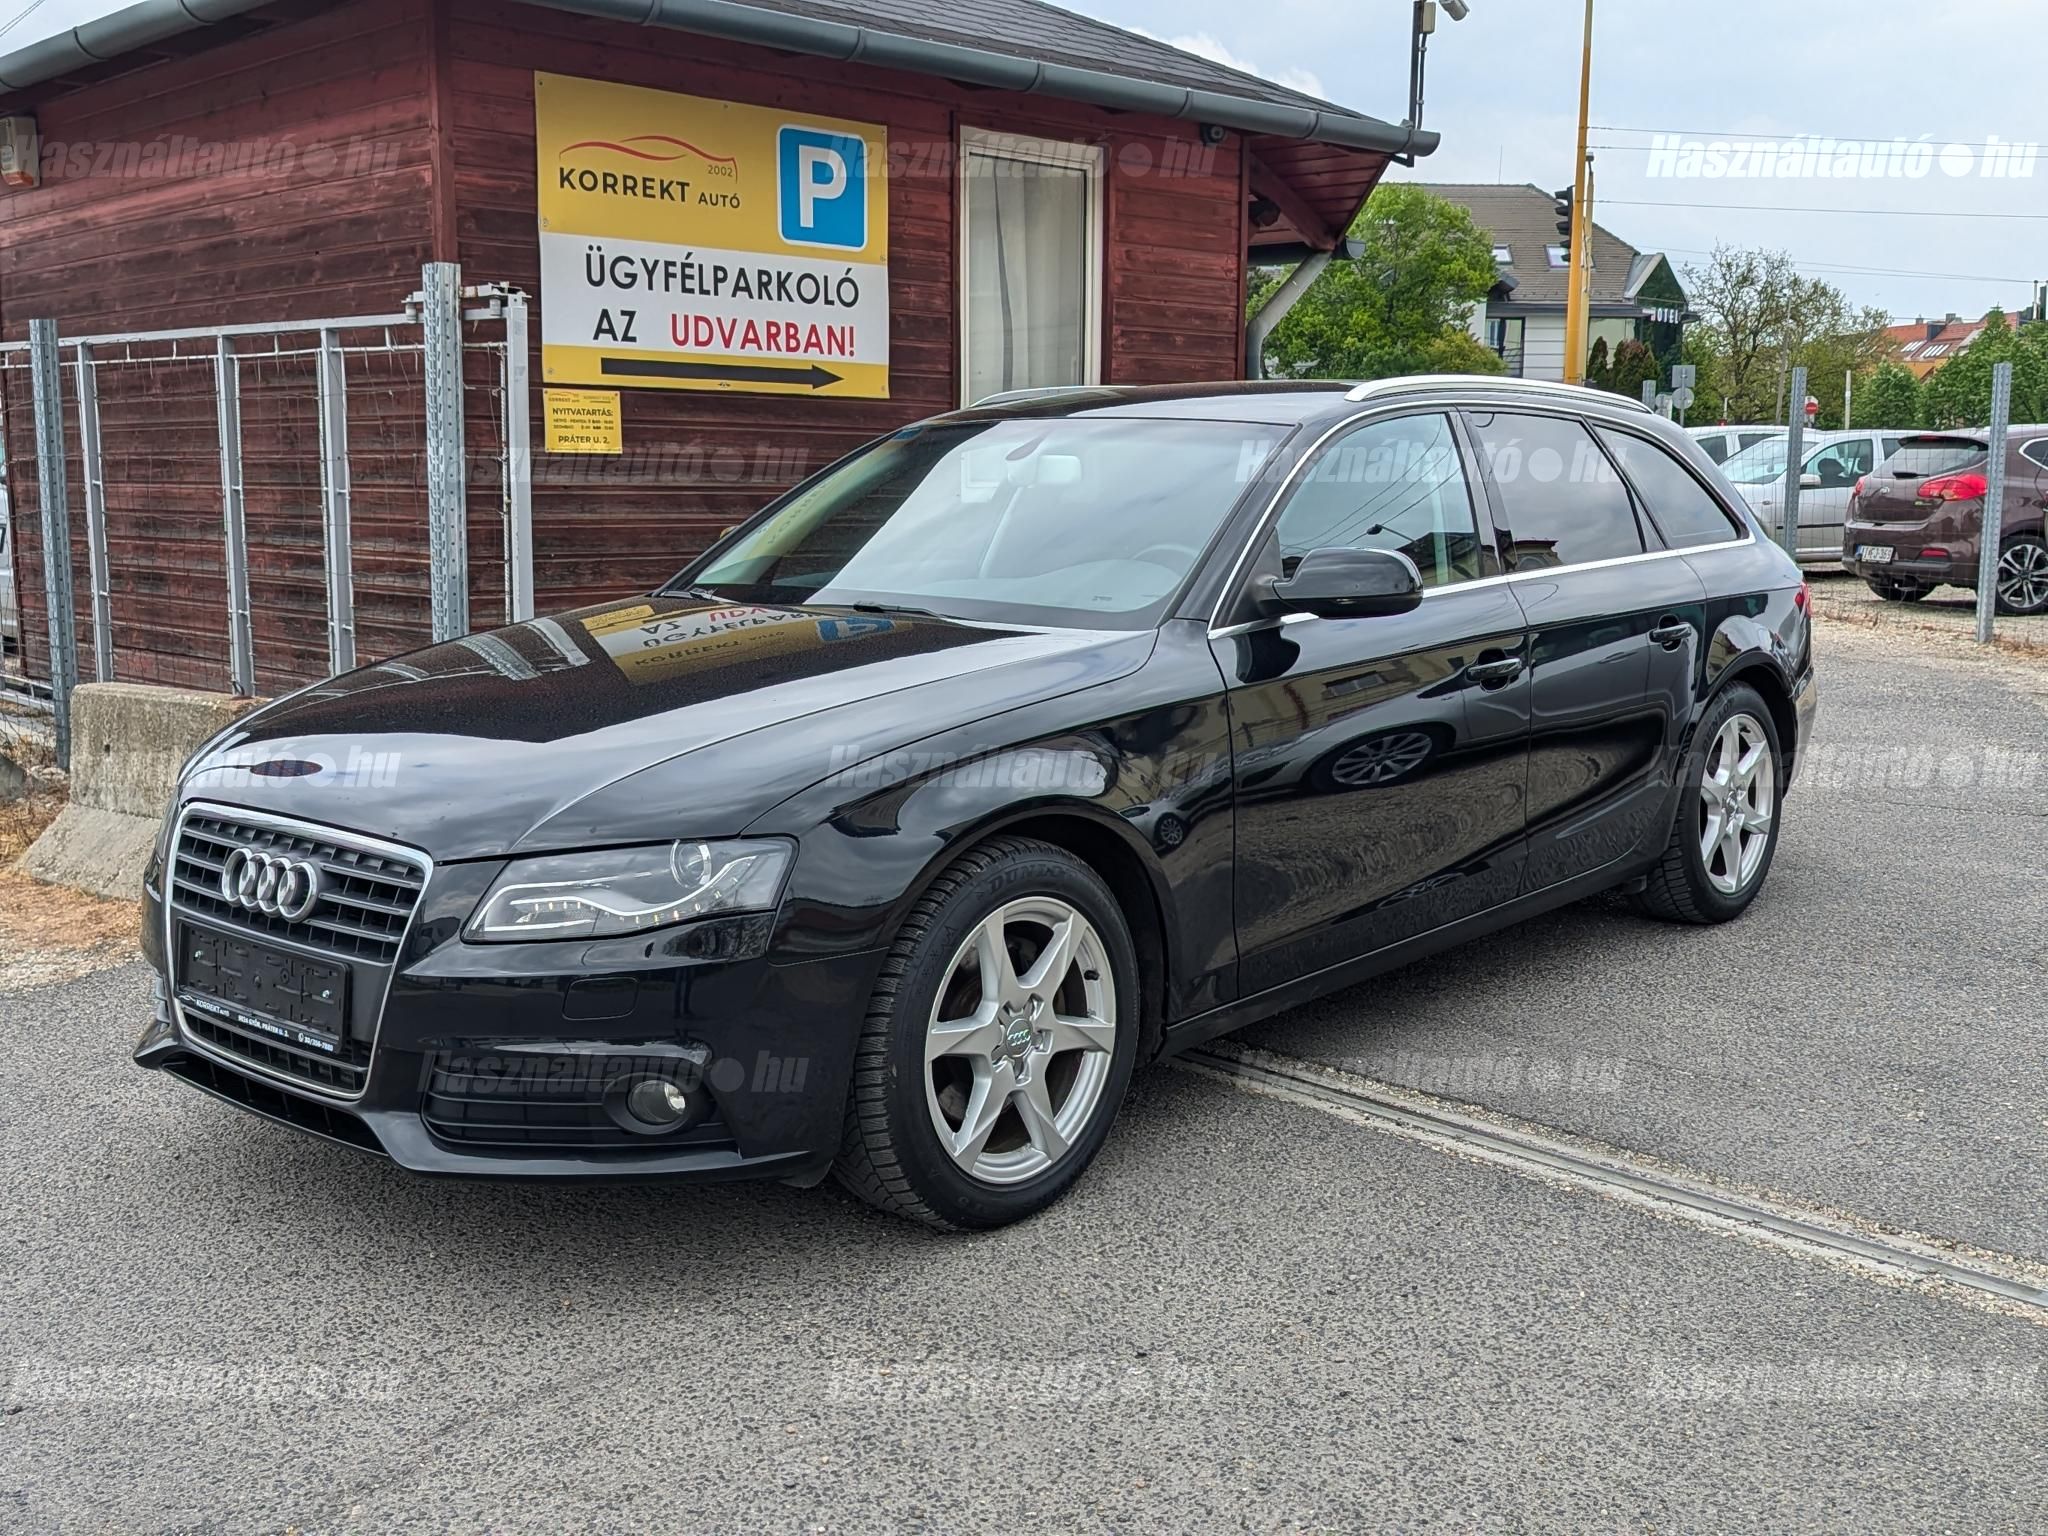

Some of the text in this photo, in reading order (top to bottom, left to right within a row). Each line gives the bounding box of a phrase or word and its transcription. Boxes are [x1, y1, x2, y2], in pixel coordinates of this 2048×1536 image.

[707, 164, 734, 178] 2002
[559, 167, 741, 209] KORREKT AUTÓ
[585, 245, 859, 308] ÜGYFÉLPARKOLÓ
[593, 308, 856, 357] AZ UDVARBAN!
[552, 407, 614, 417] NYITVATARTÁS:
[558, 434, 592, 444] PRÁTER
